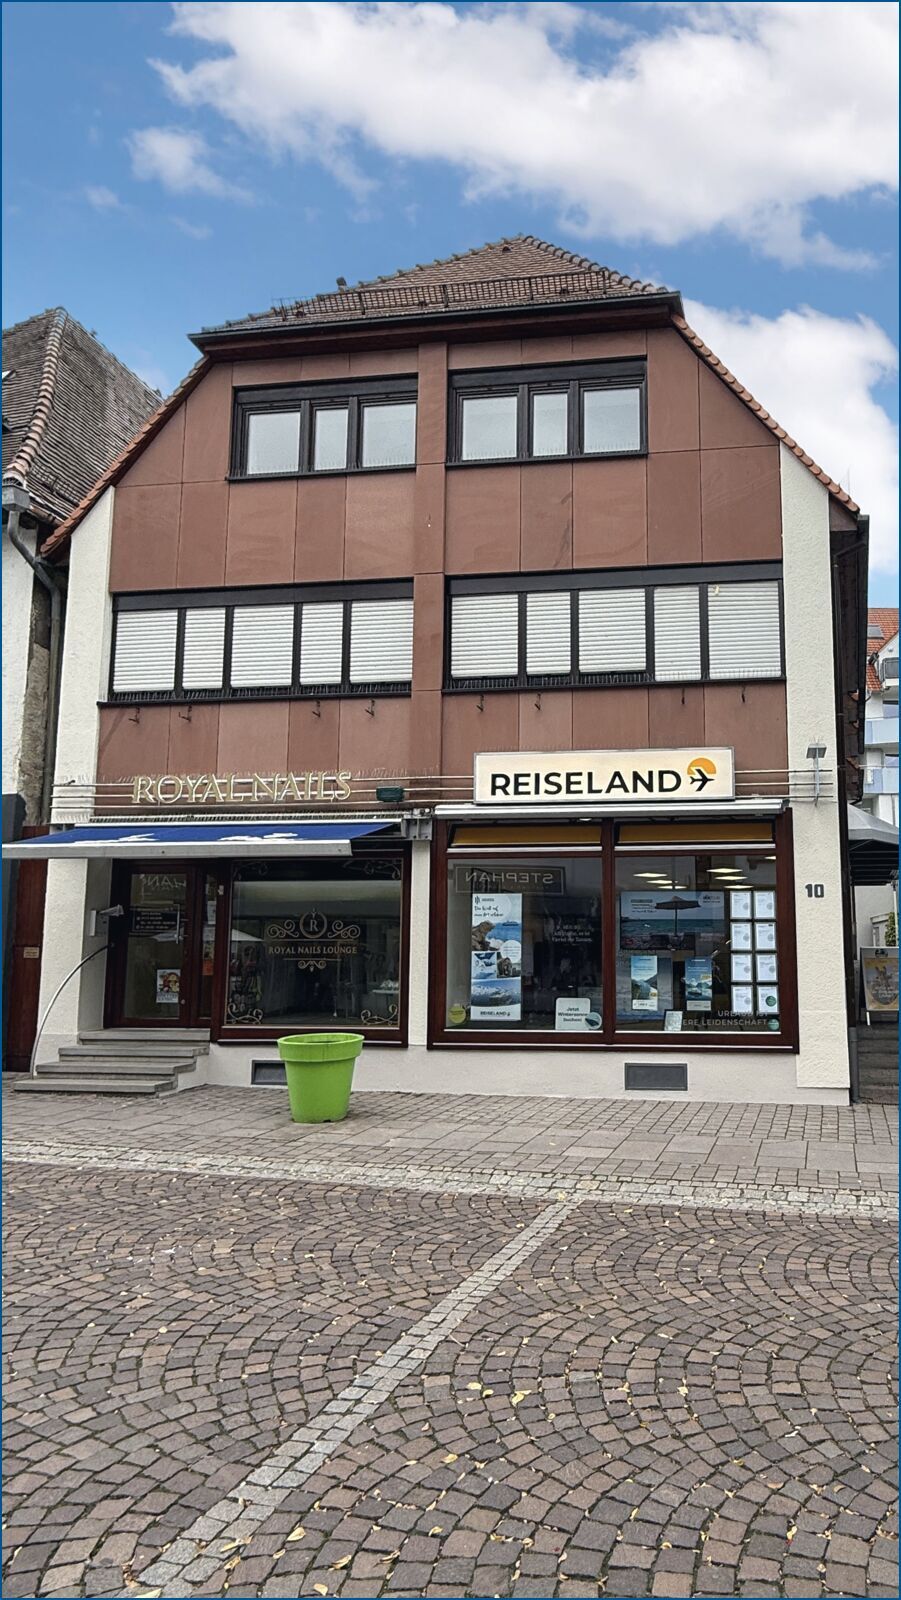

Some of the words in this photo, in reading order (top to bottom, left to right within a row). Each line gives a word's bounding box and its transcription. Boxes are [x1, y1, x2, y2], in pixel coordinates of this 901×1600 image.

[131, 773, 244, 804] ROYAL
[250, 771, 353, 802] NAILS
[490, 769, 682, 796] REISELAND
[804, 883, 825, 898] 10
[268, 945, 297, 955] ROYAL
[297, 945, 322, 955] NAILS
[322, 945, 358, 955] LOUNGE
[702, 1018, 767, 1026] LEIDENSCHAFT
